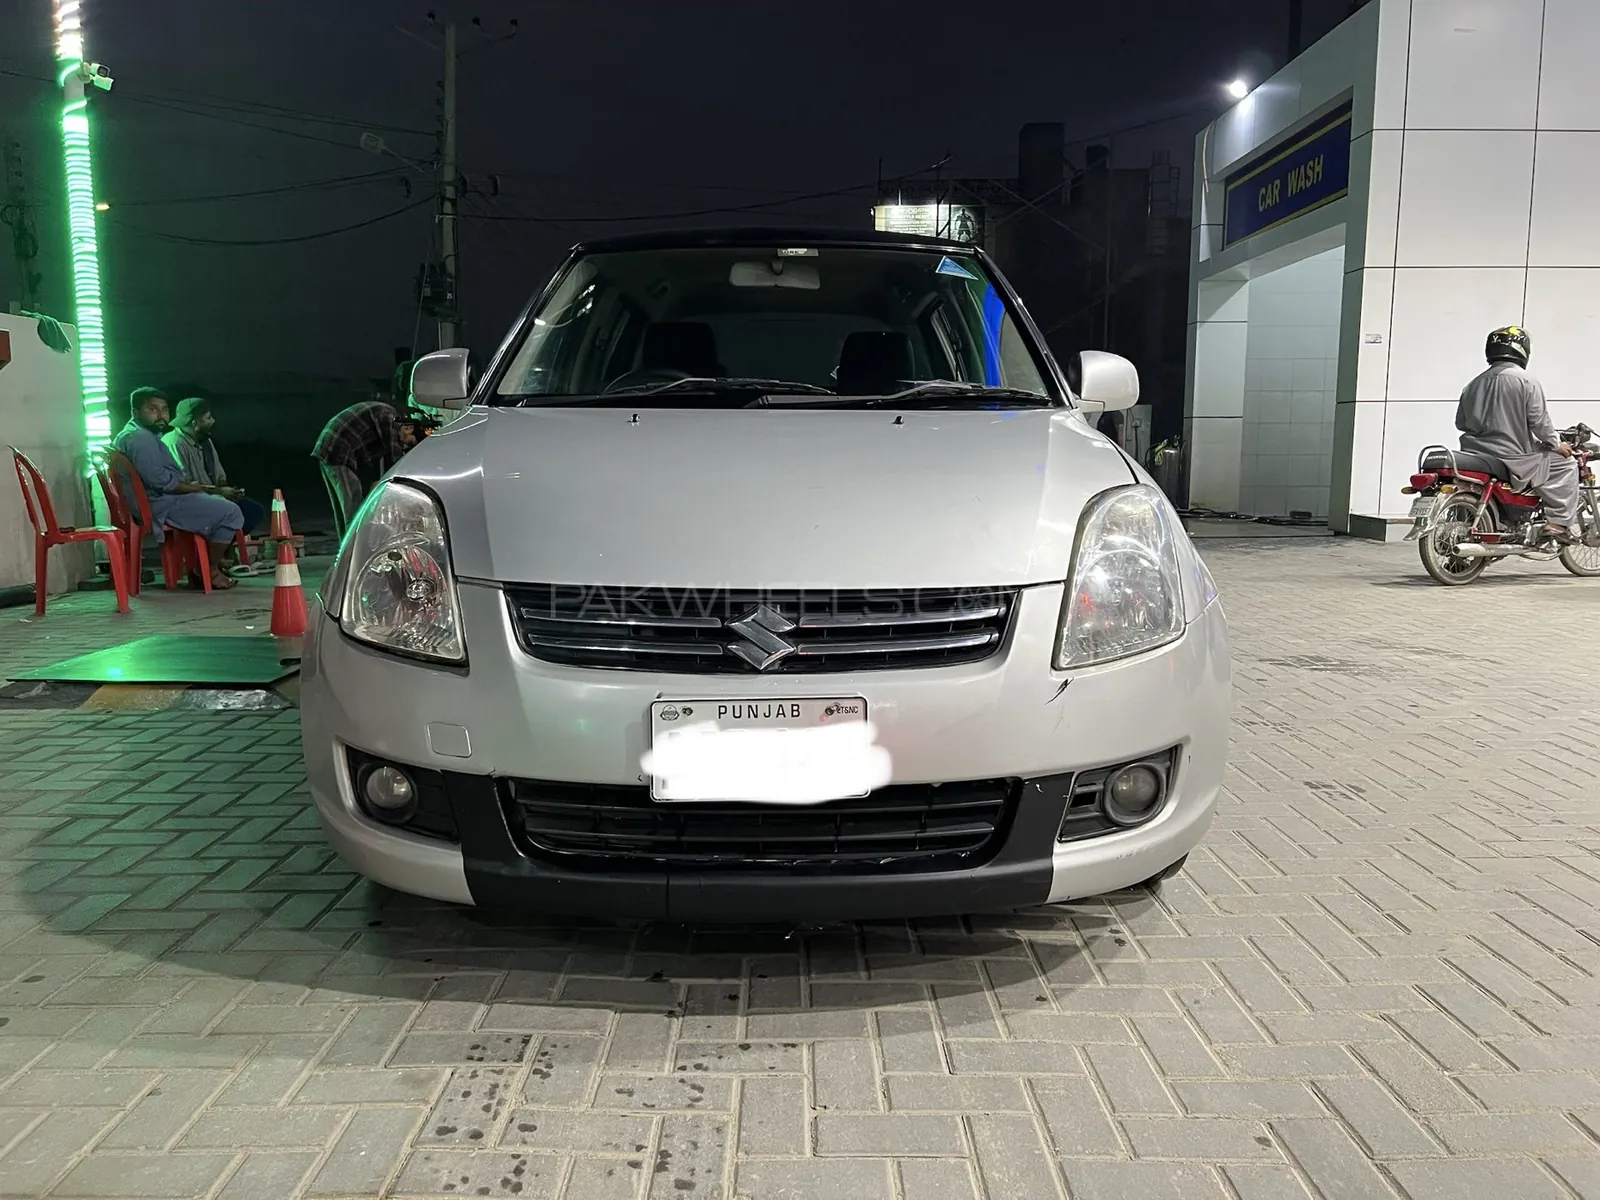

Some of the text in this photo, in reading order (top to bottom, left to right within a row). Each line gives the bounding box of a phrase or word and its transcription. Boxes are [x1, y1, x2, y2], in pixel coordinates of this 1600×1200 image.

[1259, 154, 1323, 212] CAR WASH
[718, 703, 801, 720] PUNJAB
